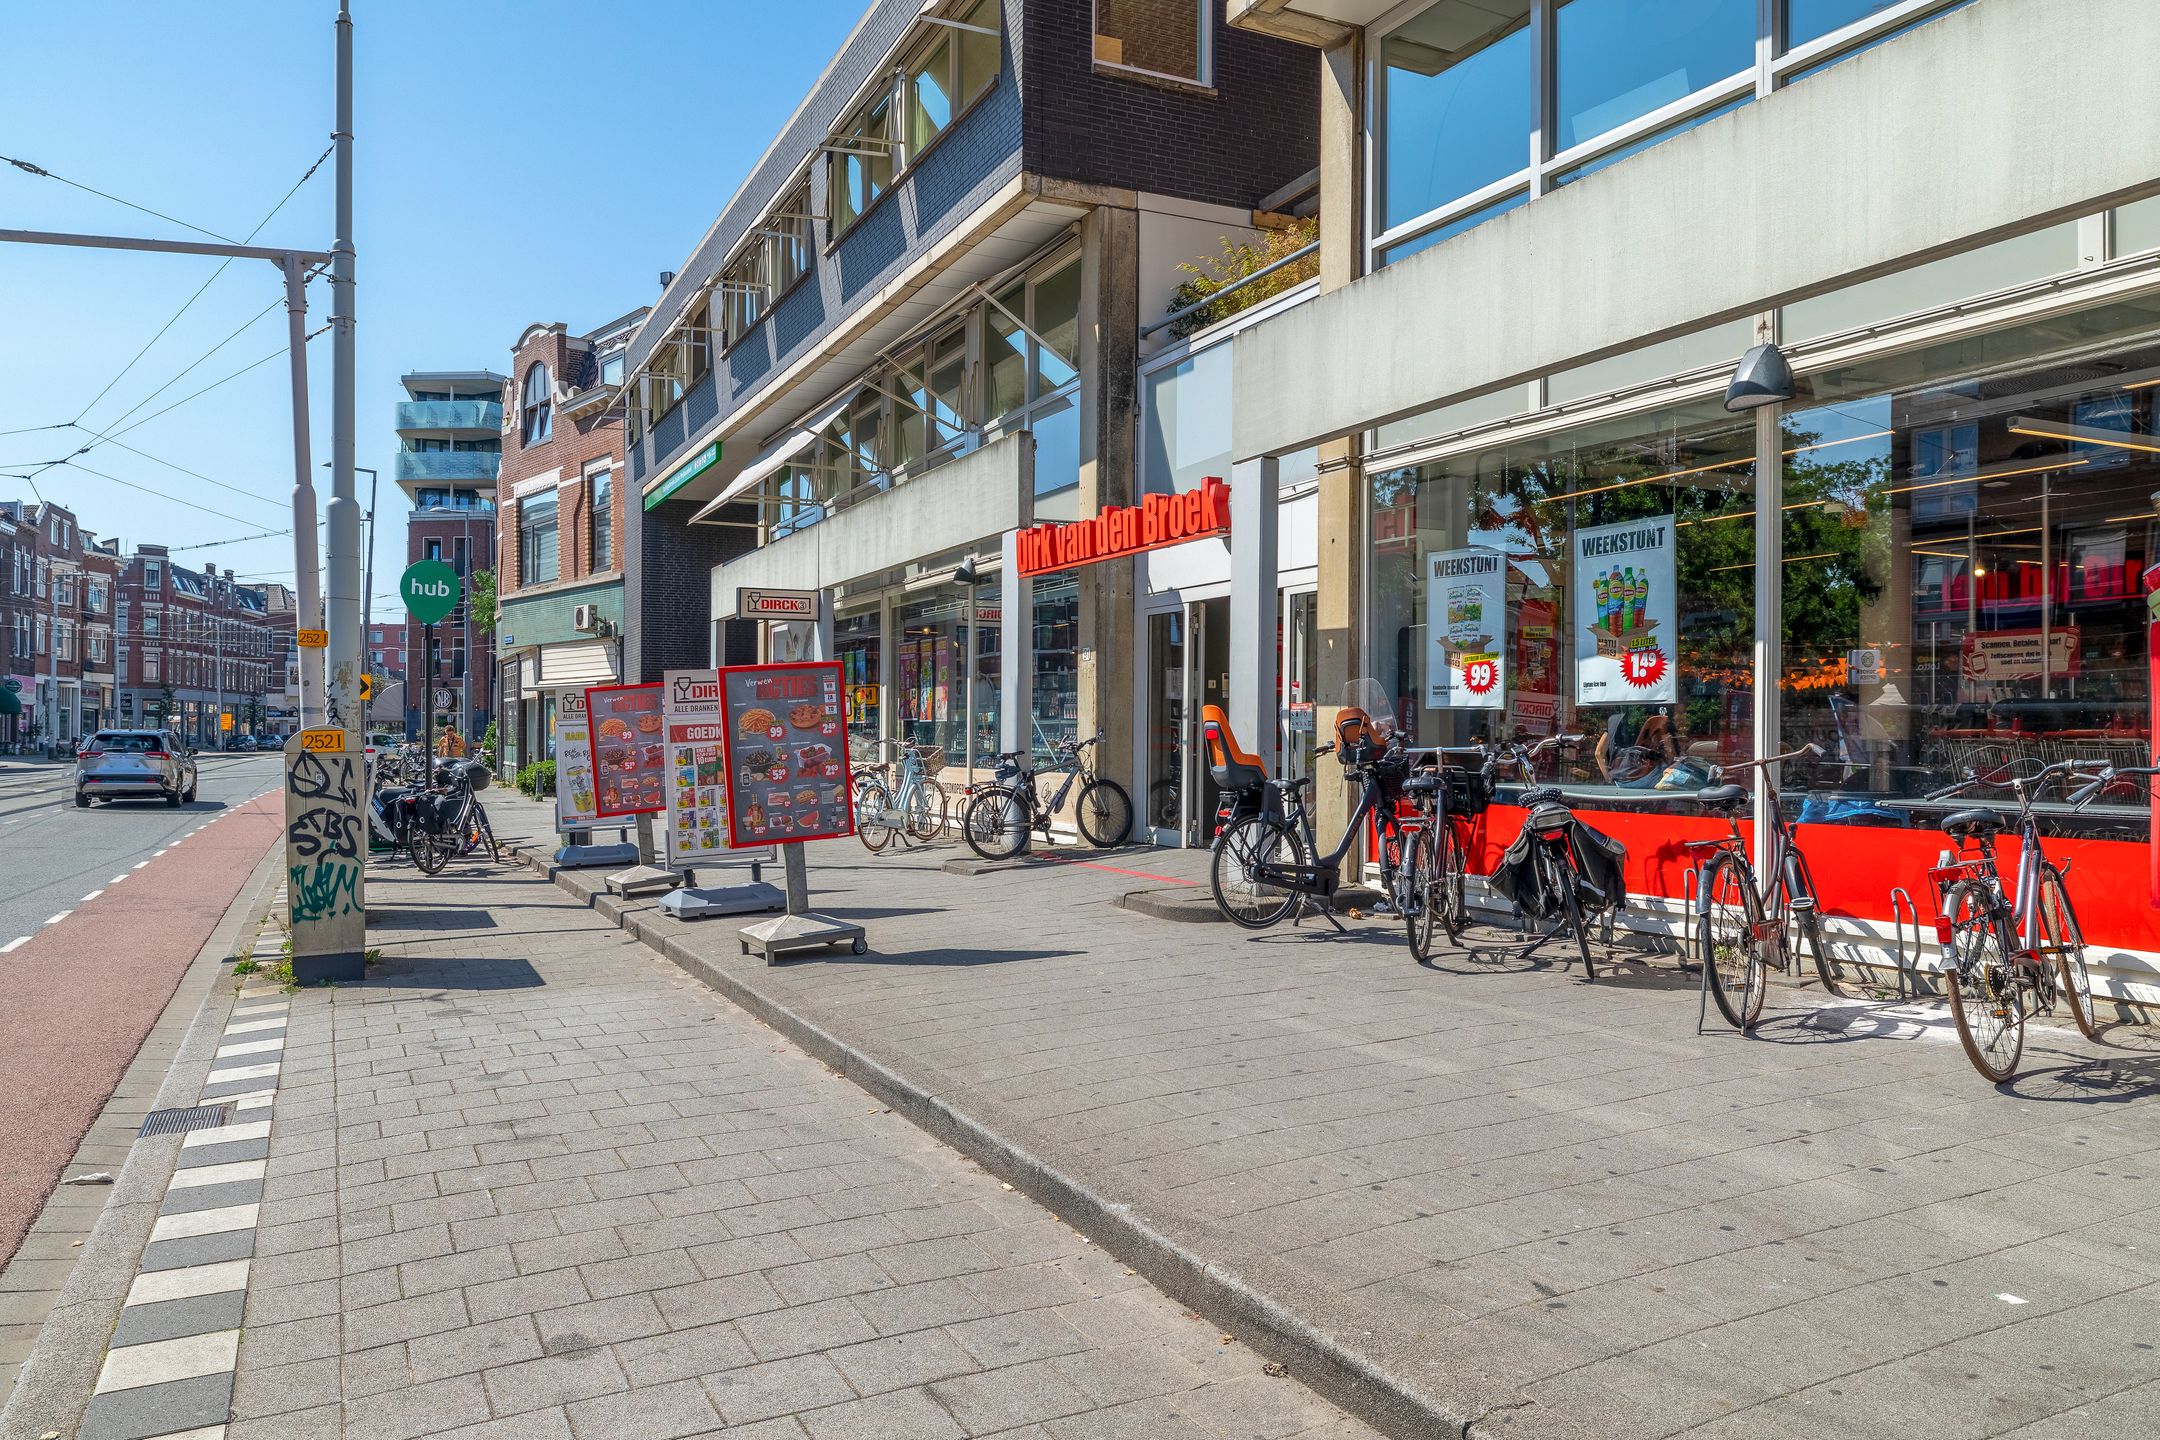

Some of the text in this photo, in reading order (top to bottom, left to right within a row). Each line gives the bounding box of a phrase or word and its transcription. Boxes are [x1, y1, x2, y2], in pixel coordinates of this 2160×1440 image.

[1017, 478, 1222, 573] Dirk van den Broek
[1582, 527, 1665, 557] WEEKSTUNT
[1434, 554, 1499, 577] WEEKSTUNT
[411, 577, 450, 597] hub
[761, 599, 798, 611] DIRCK
[1631, 653, 1657, 678] 1.49
[745, 677, 773, 688] Verwen
[1471, 664, 1491, 687] 99
[674, 705, 689, 713] ALLE
[622, 731, 632, 739] 99
[770, 727, 782, 737] 99
[773, 769, 786, 780] 5.99
